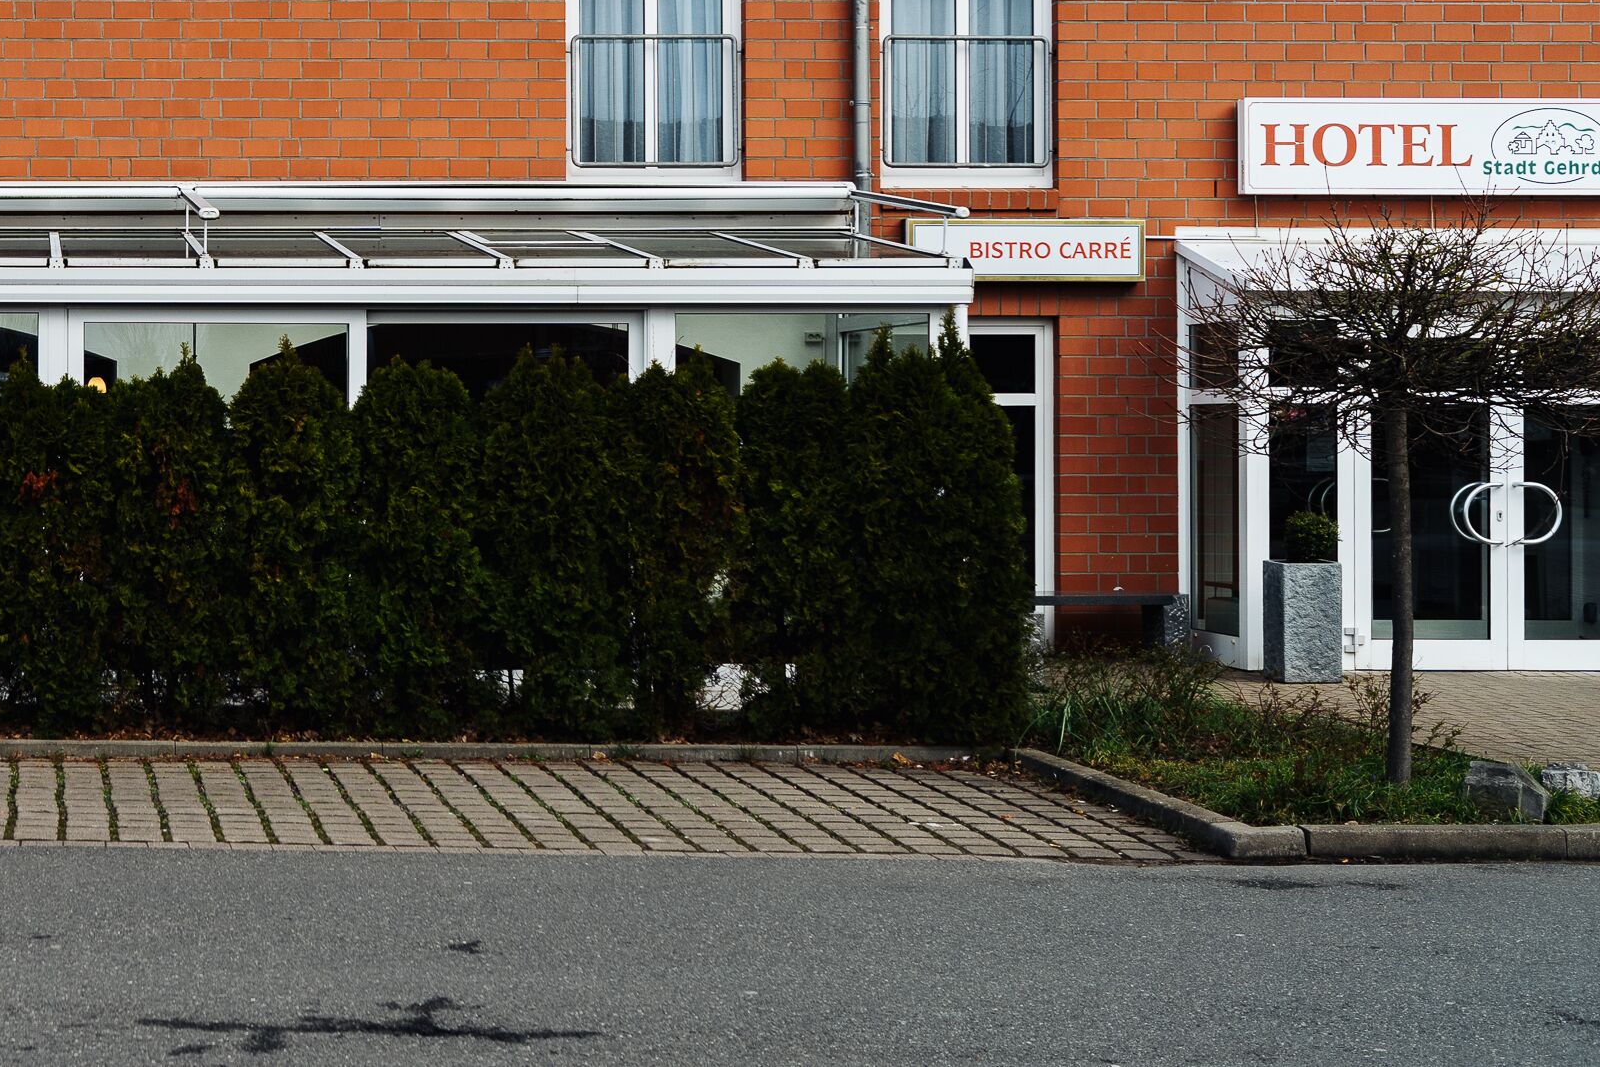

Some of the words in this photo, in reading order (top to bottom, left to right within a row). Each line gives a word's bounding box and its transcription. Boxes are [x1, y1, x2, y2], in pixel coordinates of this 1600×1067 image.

[1260, 122, 1473, 167] HOTEL
[1483, 160, 1537, 175] Stadt
[1544, 160, 1600, 175] Gehrd
[969, 241, 1051, 259] BISTRO
[1059, 236, 1132, 259] CARRÉ
